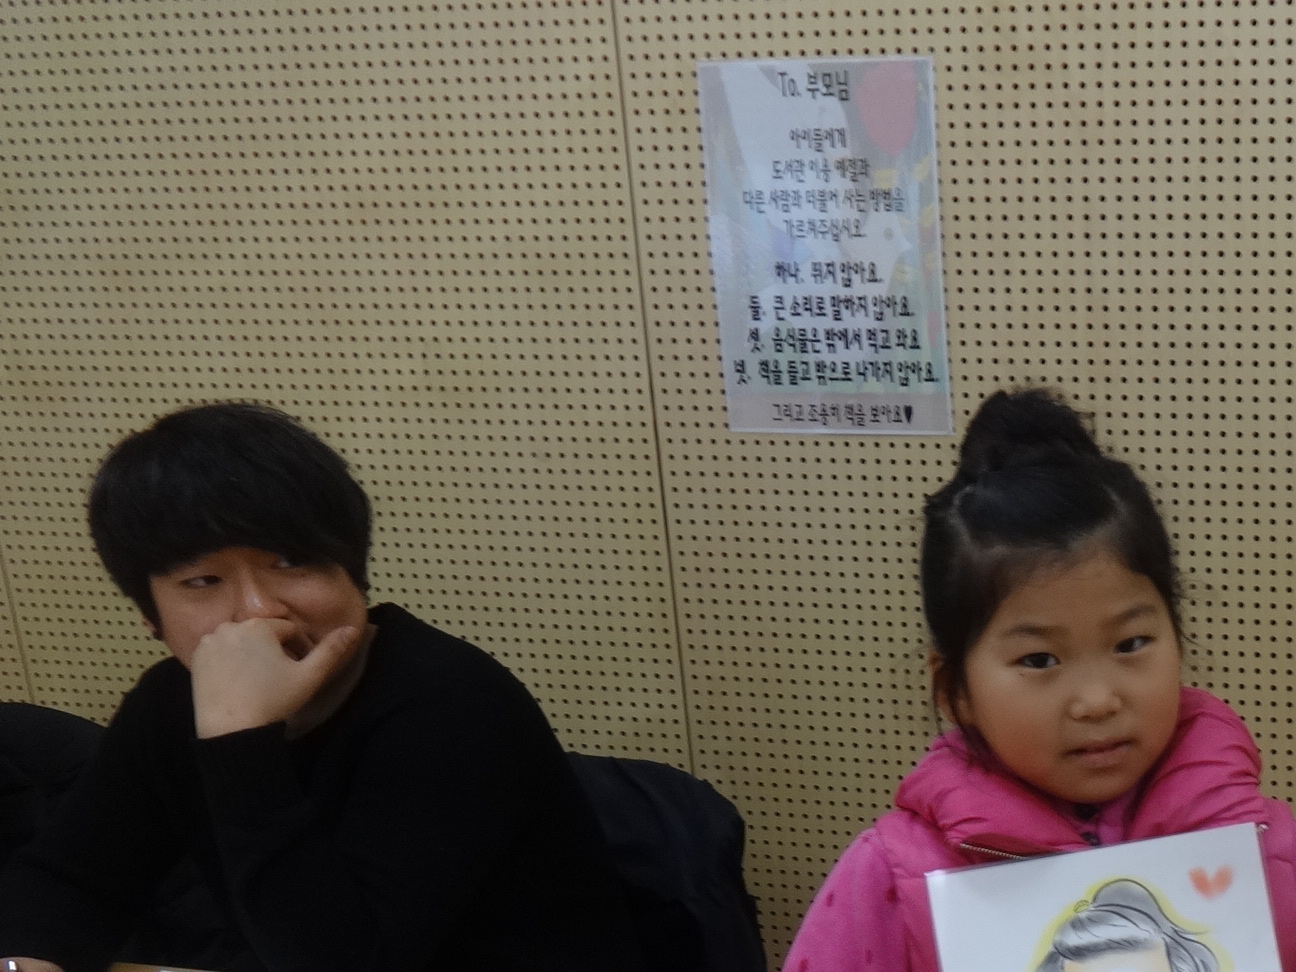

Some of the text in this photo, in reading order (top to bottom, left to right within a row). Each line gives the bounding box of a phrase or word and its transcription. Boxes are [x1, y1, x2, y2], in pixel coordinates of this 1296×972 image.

[806, 70, 849, 101] 부모님
[790, 127, 847, 152] 아이들에게
[772, 157, 870, 183] 도서관 이용 예절과
[742, 187, 905, 214] 다른 사람과 더불어 사는 방법을
[773, 295, 785, 321] 큰
[791, 295, 827, 317] 소리로
[829, 294, 869, 321] 말하지
[772, 327, 822, 354] 음식물은
[824, 328, 862, 354] 밖에서
[866, 328, 892, 354] 먹고
[758, 359, 783, 385] 책을
[787, 360, 811, 385] 들고
[815, 360, 852, 386] 밖으로
[855, 360, 895, 383] 나가지
[772, 404, 804, 421] 그리고
[808, 404, 842, 426] 조용히
[845, 404, 866, 426] 책을
